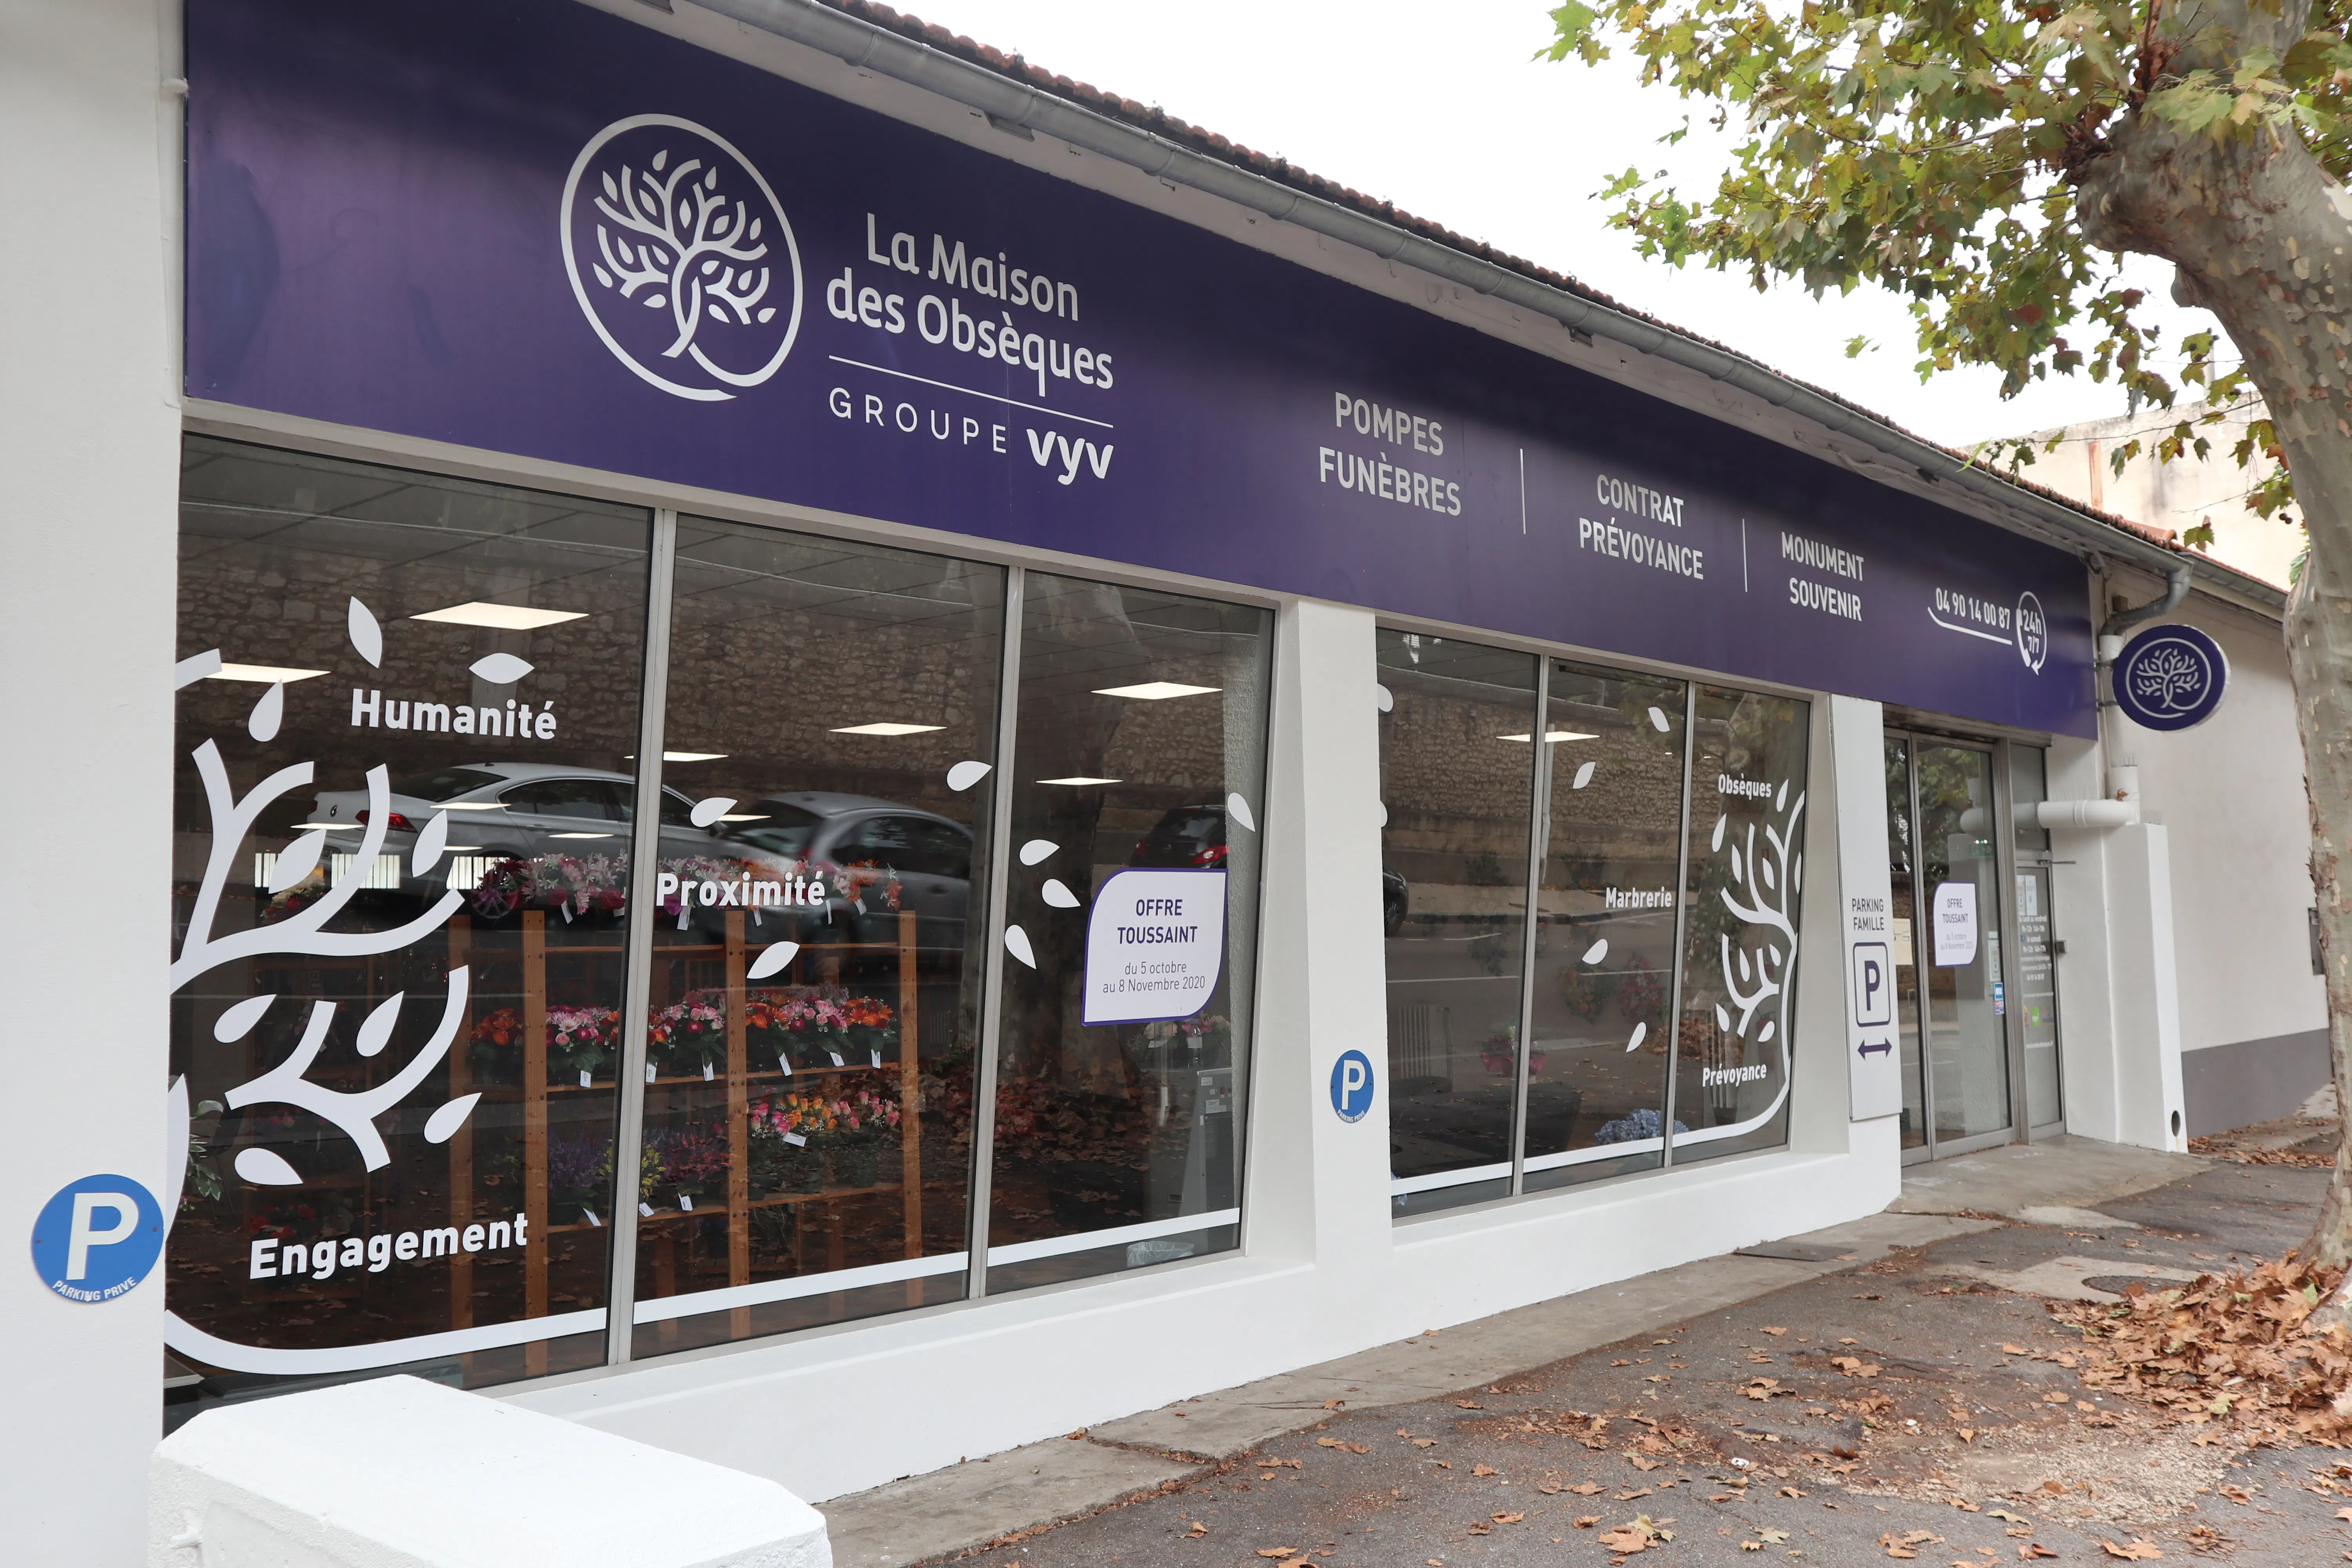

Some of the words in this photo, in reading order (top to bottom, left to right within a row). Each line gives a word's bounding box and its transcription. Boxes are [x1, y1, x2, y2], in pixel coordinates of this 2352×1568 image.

[867, 212, 919, 274] La
[928, 234, 1078, 321] Maison
[827, 267, 905, 334] des
[918, 295, 1114, 397] Obsèques
[829, 387, 1007, 454] GROUPE
[1026, 428, 1114, 485] vyv
[1335, 392, 1444, 456] POMPES
[1319, 446, 1461, 516] FUNÈBRES
[1597, 475, 1684, 527] CONTRAT
[1579, 517, 1704, 580] PRÉVOYANCE
[1782, 532, 1864, 581] MONUMENT
[1789, 577, 1862, 622] SOUVENIR
[1936, 588, 1950, 613] 04
[1952, 592, 1966, 617] 90
[1969, 597, 1982, 622] 14
[1984, 602, 1996, 626] 00
[1999, 606, 2010, 630] 87
[2023, 609, 2042, 635] 24h
[2027, 635, 2039, 653] 7/7
[351, 688, 556, 740] Humanité
[1718, 773, 1772, 800] Obsèques
[657, 871, 826, 907] Proximité
[1606, 886, 1672, 908] Marbrerie
[1852, 898, 1884, 912] PARKING
[1947, 898, 1963, 908] OFFRE
[1136, 899, 1183, 916] OFFRE
[1853, 917, 1885, 931] FAMILLE
[1942, 913, 1968, 923] TOUSSAINT
[1117, 926, 1198, 944] TOUSSAINT
[1103, 983, 1115, 993] au
[1119, 979, 1125, 992] 8
[1128, 978, 1179, 991] Novembre
[1183, 976, 1205, 989] 2020
[1125, 962, 1137, 975] du
[1141, 962, 1146, 974] 5
[1150, 960, 1187, 974] octobre
[1864, 960, 1880, 1011] P
[1341, 1060, 1366, 1110] P
[1702, 1064, 1767, 1087] Prévoyance
[1337, 1109, 1354, 1122] PARKING
[1354, 1110, 1365, 1122] PRIVE
[66, 1192, 138, 1280] P
[250, 1212, 528, 1279] Engagement
[52, 1280, 101, 1302] PARKING
[104, 1276, 137, 1299] PRIVE
